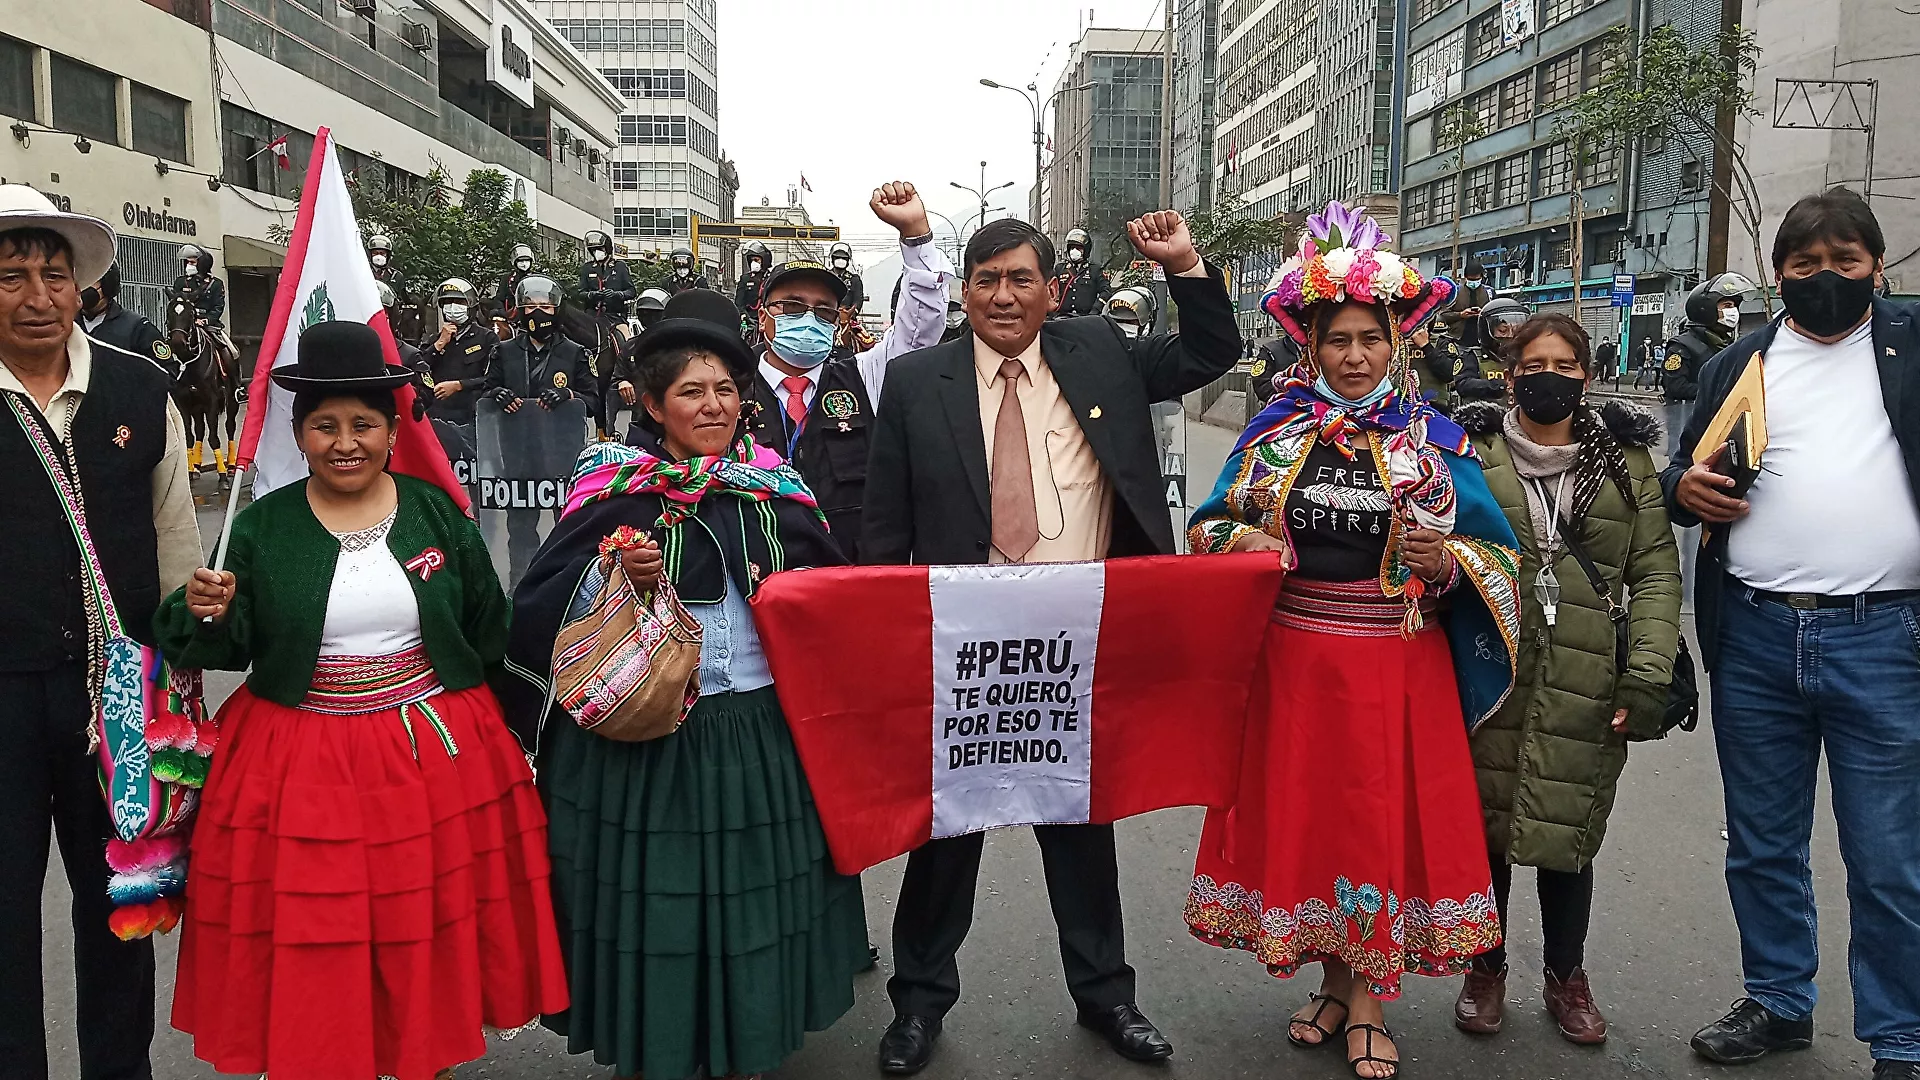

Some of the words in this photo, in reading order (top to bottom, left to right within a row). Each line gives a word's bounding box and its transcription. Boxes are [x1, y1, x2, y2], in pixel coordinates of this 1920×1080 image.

[135, 203, 197, 236] Inkafarma
[1316, 466, 1383, 487] FREE
[481, 478, 566, 508] POLICI
[956, 630, 1080, 681] #PERÚ,
[952, 686, 981, 711] TE
[985, 680, 1077, 710] QUIERO,
[943, 712, 990, 740] POR
[995, 708, 1042, 734] ESO
[1048, 709, 1079, 732] TE
[948, 738, 1068, 771] DEFIENDO.
